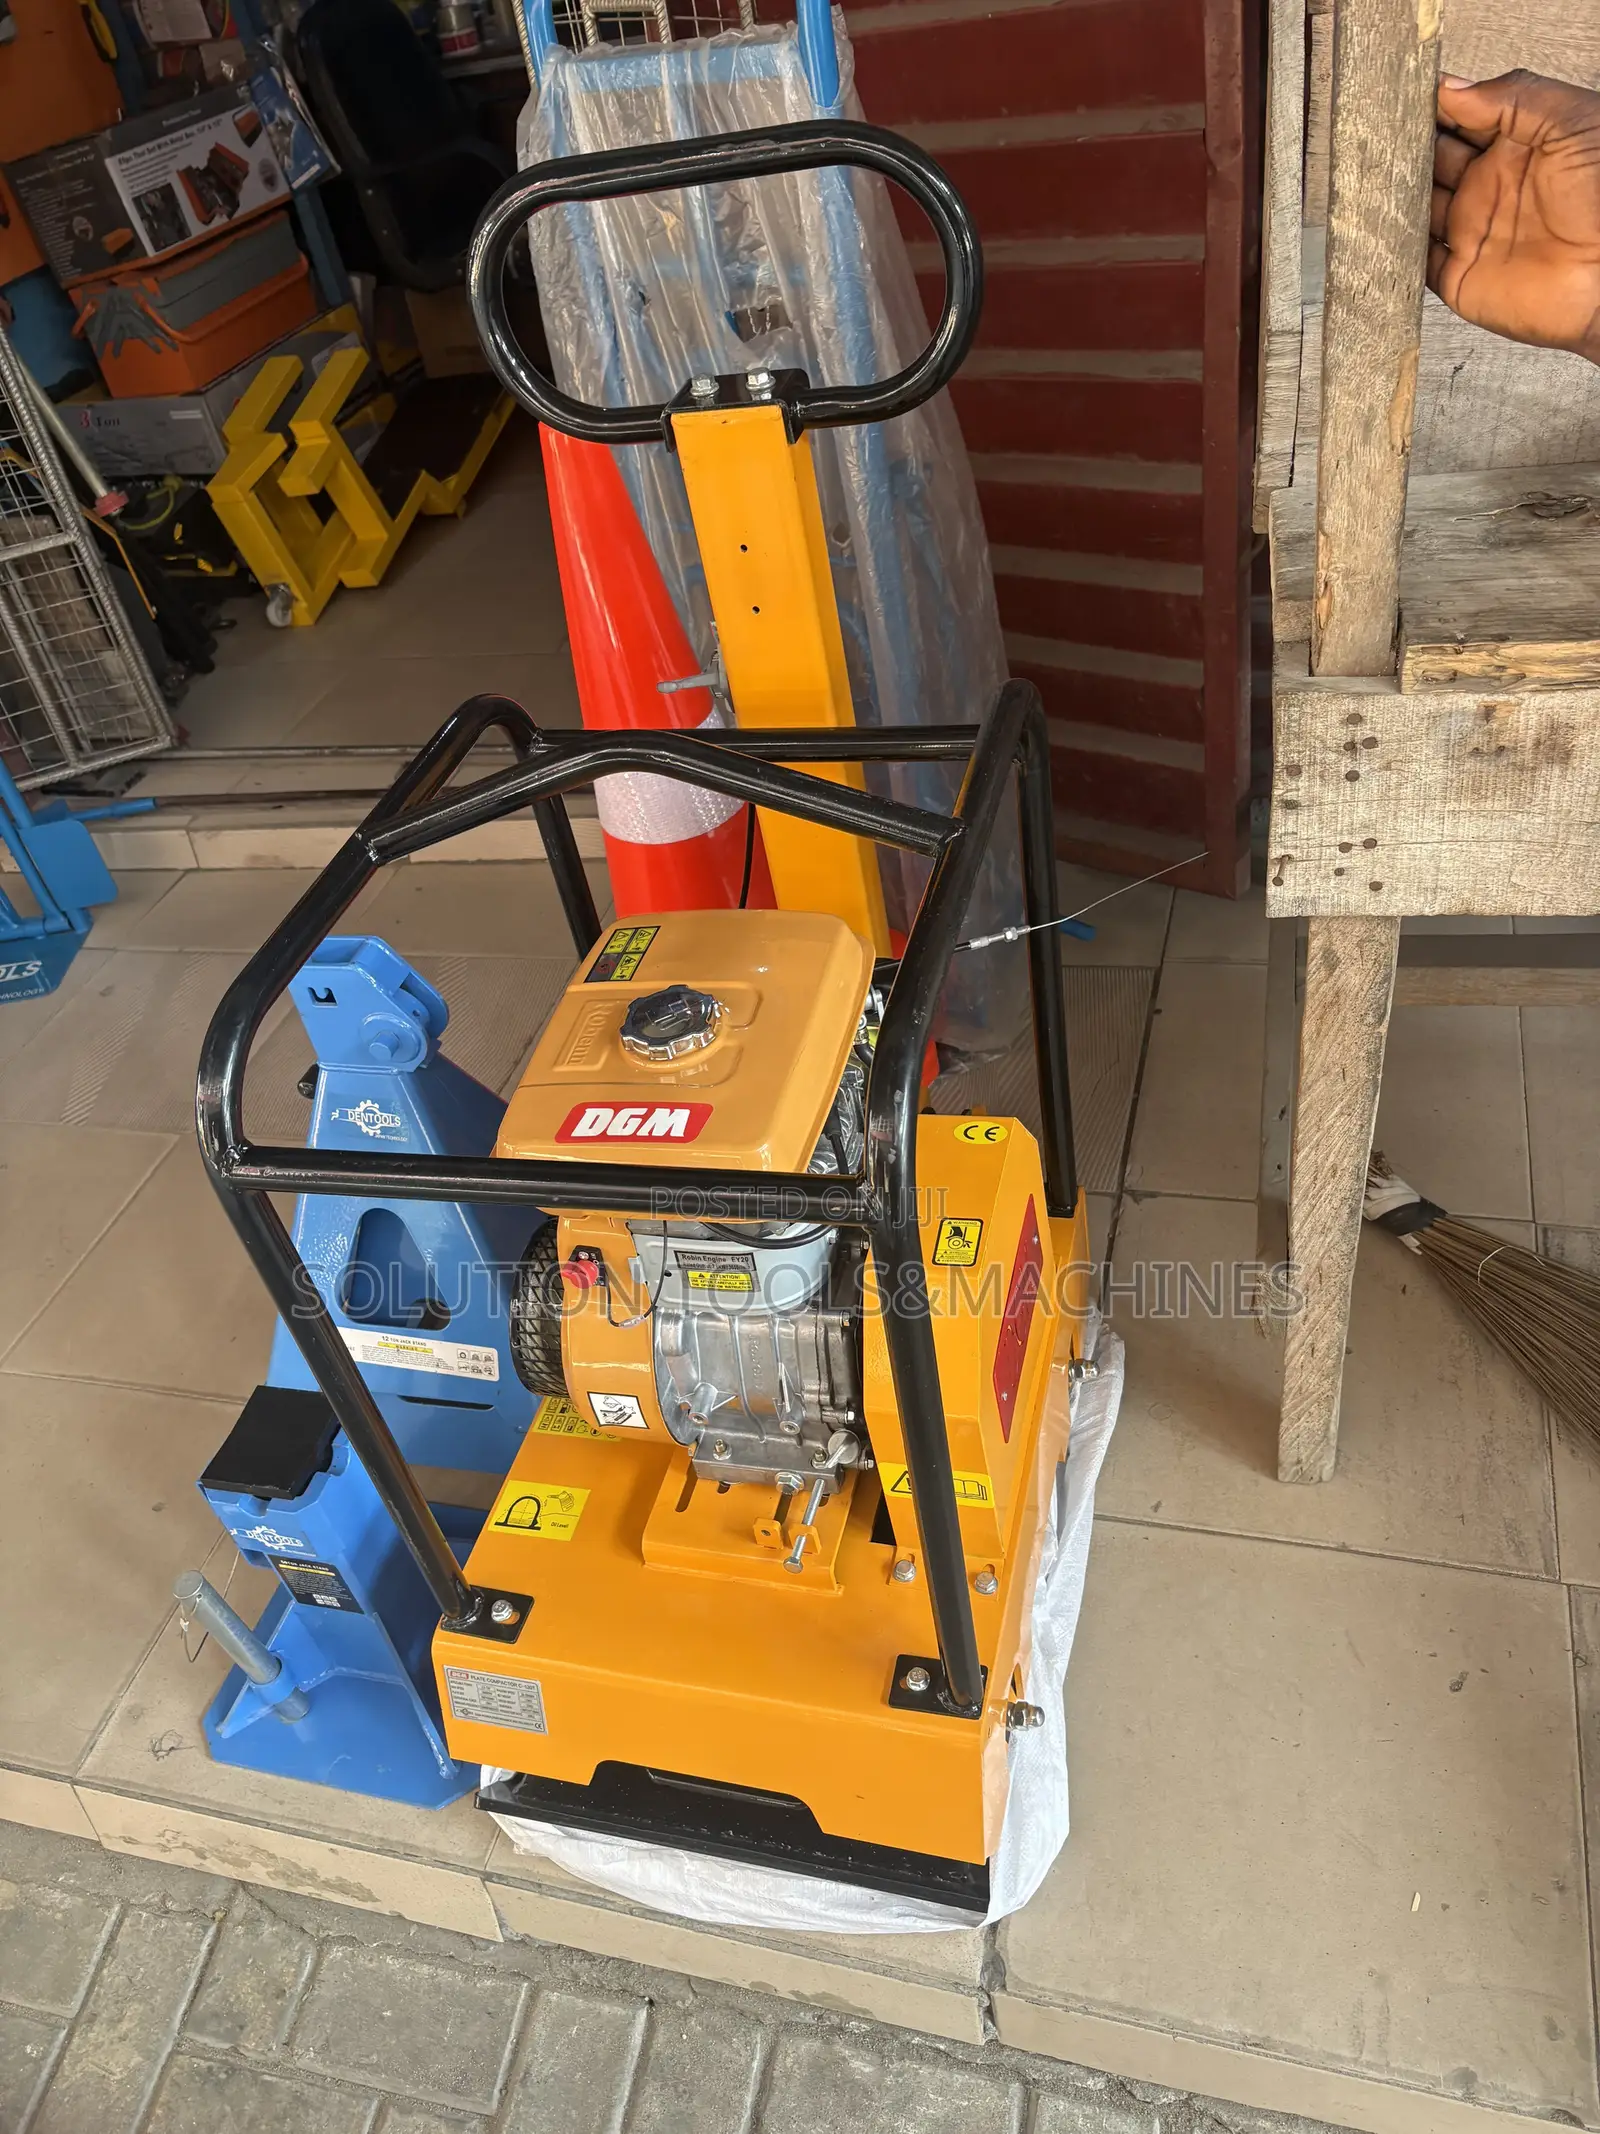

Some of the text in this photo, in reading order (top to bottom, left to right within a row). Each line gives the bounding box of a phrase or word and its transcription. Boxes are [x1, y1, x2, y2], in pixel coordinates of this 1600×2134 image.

[347, 1110, 401, 1127] DENTOOLS
[571, 1108, 691, 1137] DGM
[245, 1530, 304, 1547] DENTOOLS
[486, 1677, 518, 1688] COMPACTOR
